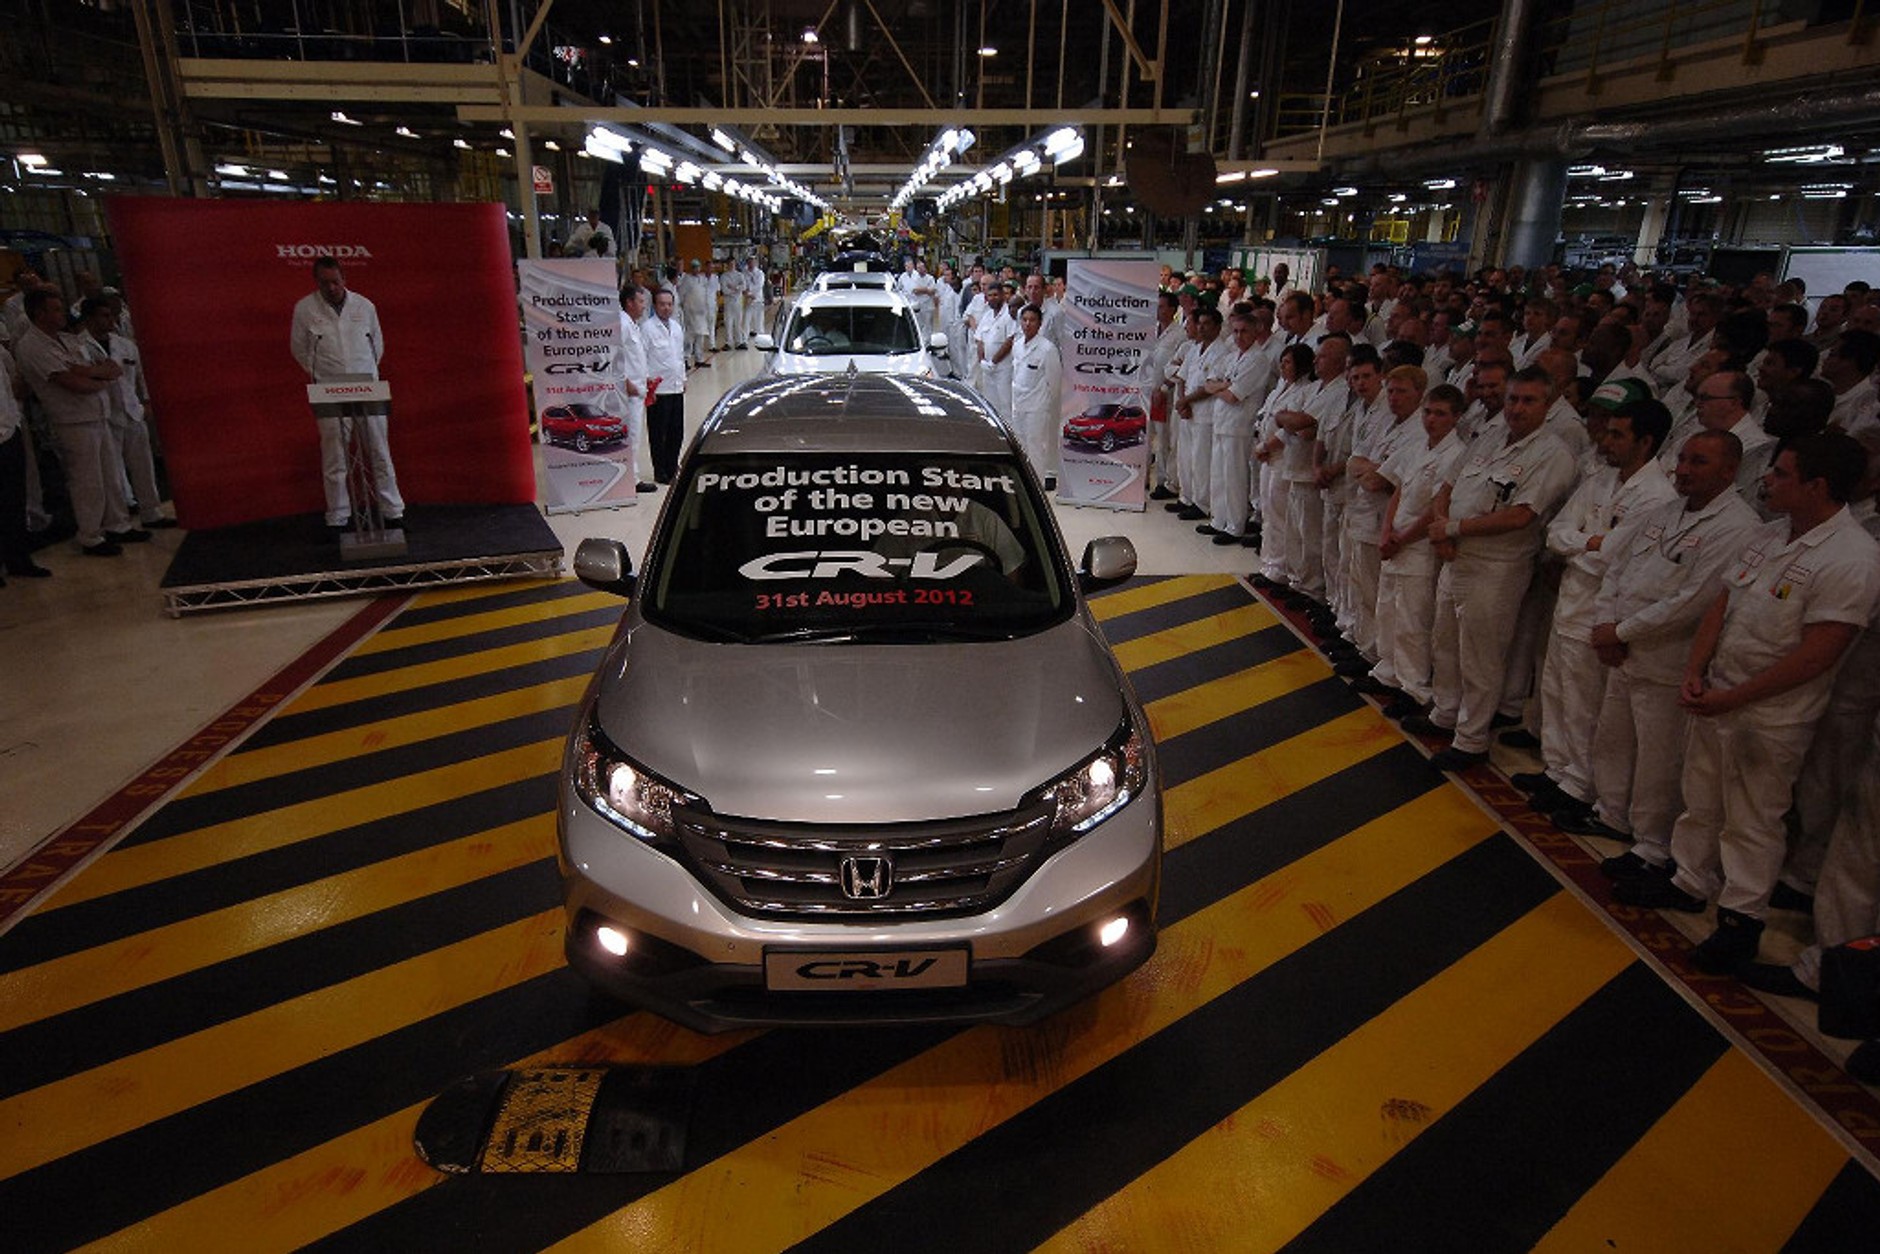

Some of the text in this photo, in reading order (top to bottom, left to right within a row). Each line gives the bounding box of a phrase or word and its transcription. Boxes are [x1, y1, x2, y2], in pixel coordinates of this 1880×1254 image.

[276, 244, 372, 258] HONDA
[532, 295, 610, 307] Production
[1074, 295, 1149, 308] Production
[556, 311, 591, 323] Start
[1094, 312, 1127, 324] Start
[537, 328, 613, 341] of the new
[1074, 328, 1147, 341] of the new
[543, 345, 610, 358] European
[1076, 345, 1141, 358] European
[544, 361, 610, 374] CR-V
[1074, 362, 1139, 375] CR-V
[325, 386, 373, 394] HONDA
[566, 385, 594, 394] August
[1091, 385, 1120, 394] August
[696, 465, 1015, 493] Production Start
[753, 489, 970, 514] of the new
[765, 516, 959, 541] European
[738, 550, 984, 580] CR-V
[755, 588, 974, 611] 31st August 2012
[796, 958, 938, 979] CR-V
